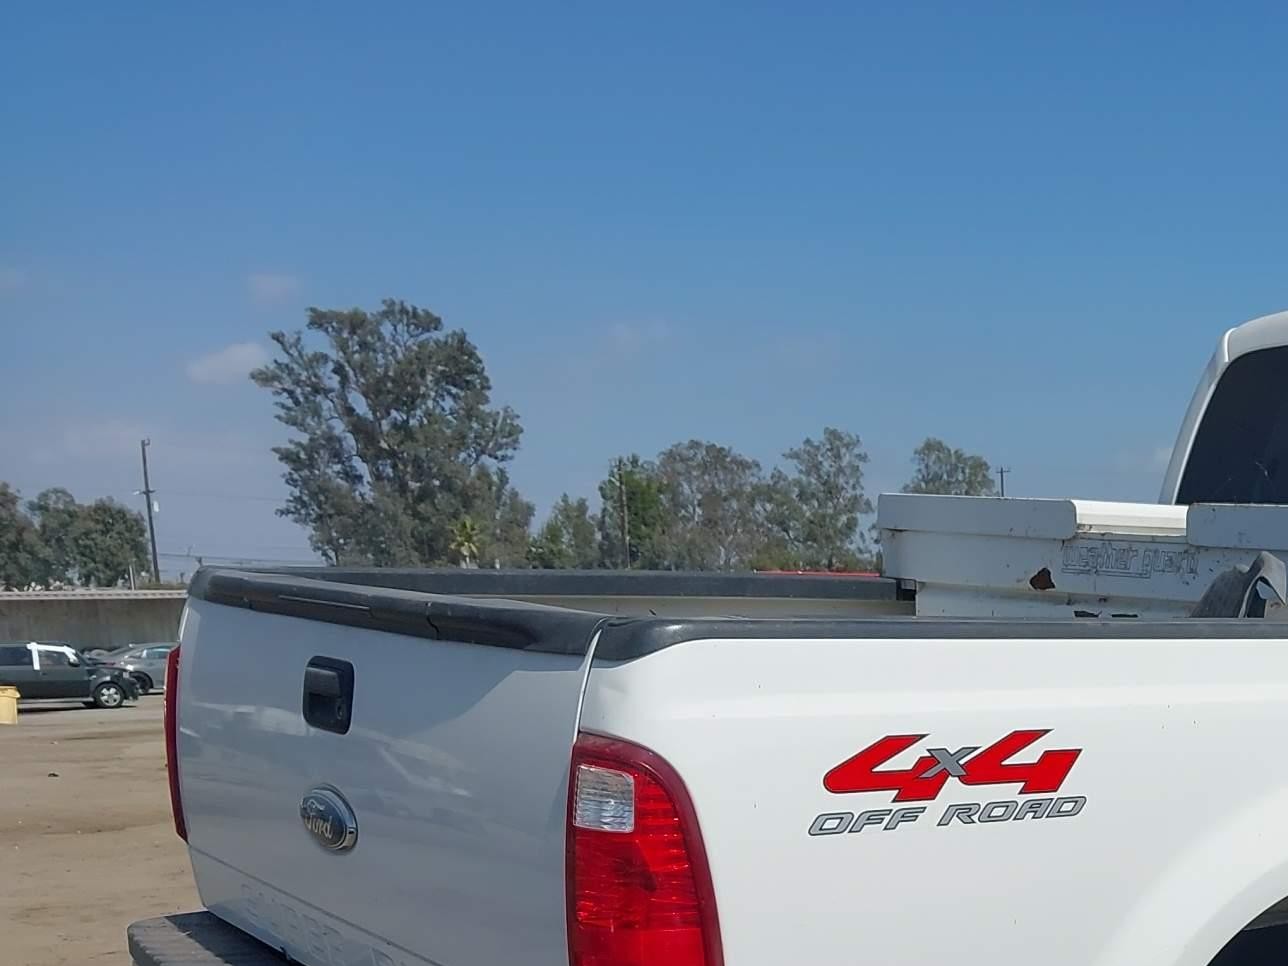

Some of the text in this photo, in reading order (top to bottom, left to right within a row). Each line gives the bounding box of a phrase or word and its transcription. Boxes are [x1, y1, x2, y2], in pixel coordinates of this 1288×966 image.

[823, 728, 1083, 803] 4x4
[304, 799, 333, 839] Ford
[808, 796, 1087, 836] OFF ROAD
